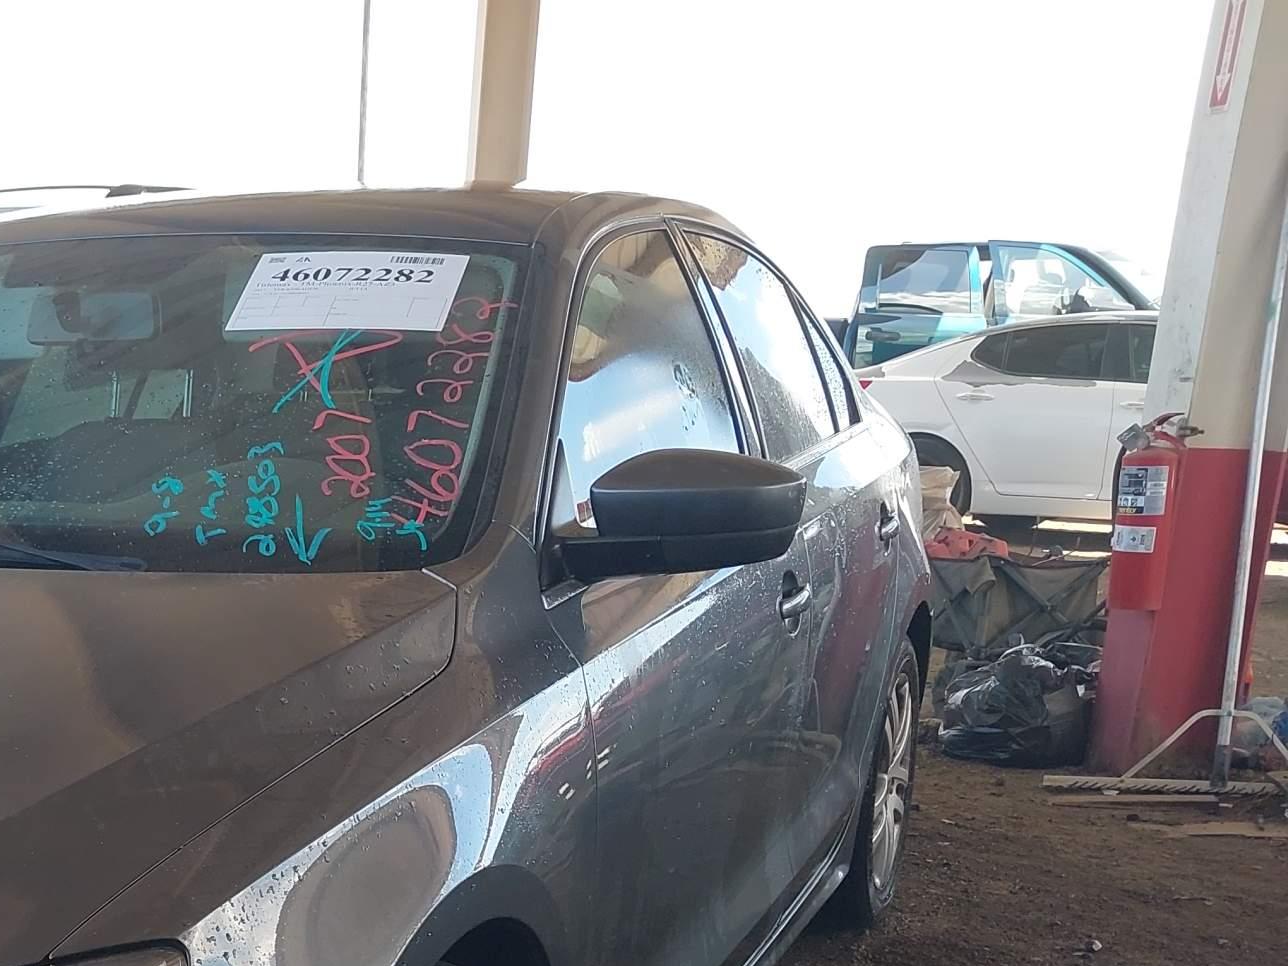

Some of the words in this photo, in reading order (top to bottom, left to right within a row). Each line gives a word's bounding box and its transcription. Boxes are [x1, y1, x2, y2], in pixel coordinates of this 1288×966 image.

[271, 267, 434, 283] 46072282
[312, 410, 376, 498] 2007
[391, 296, 518, 526] 46072282
